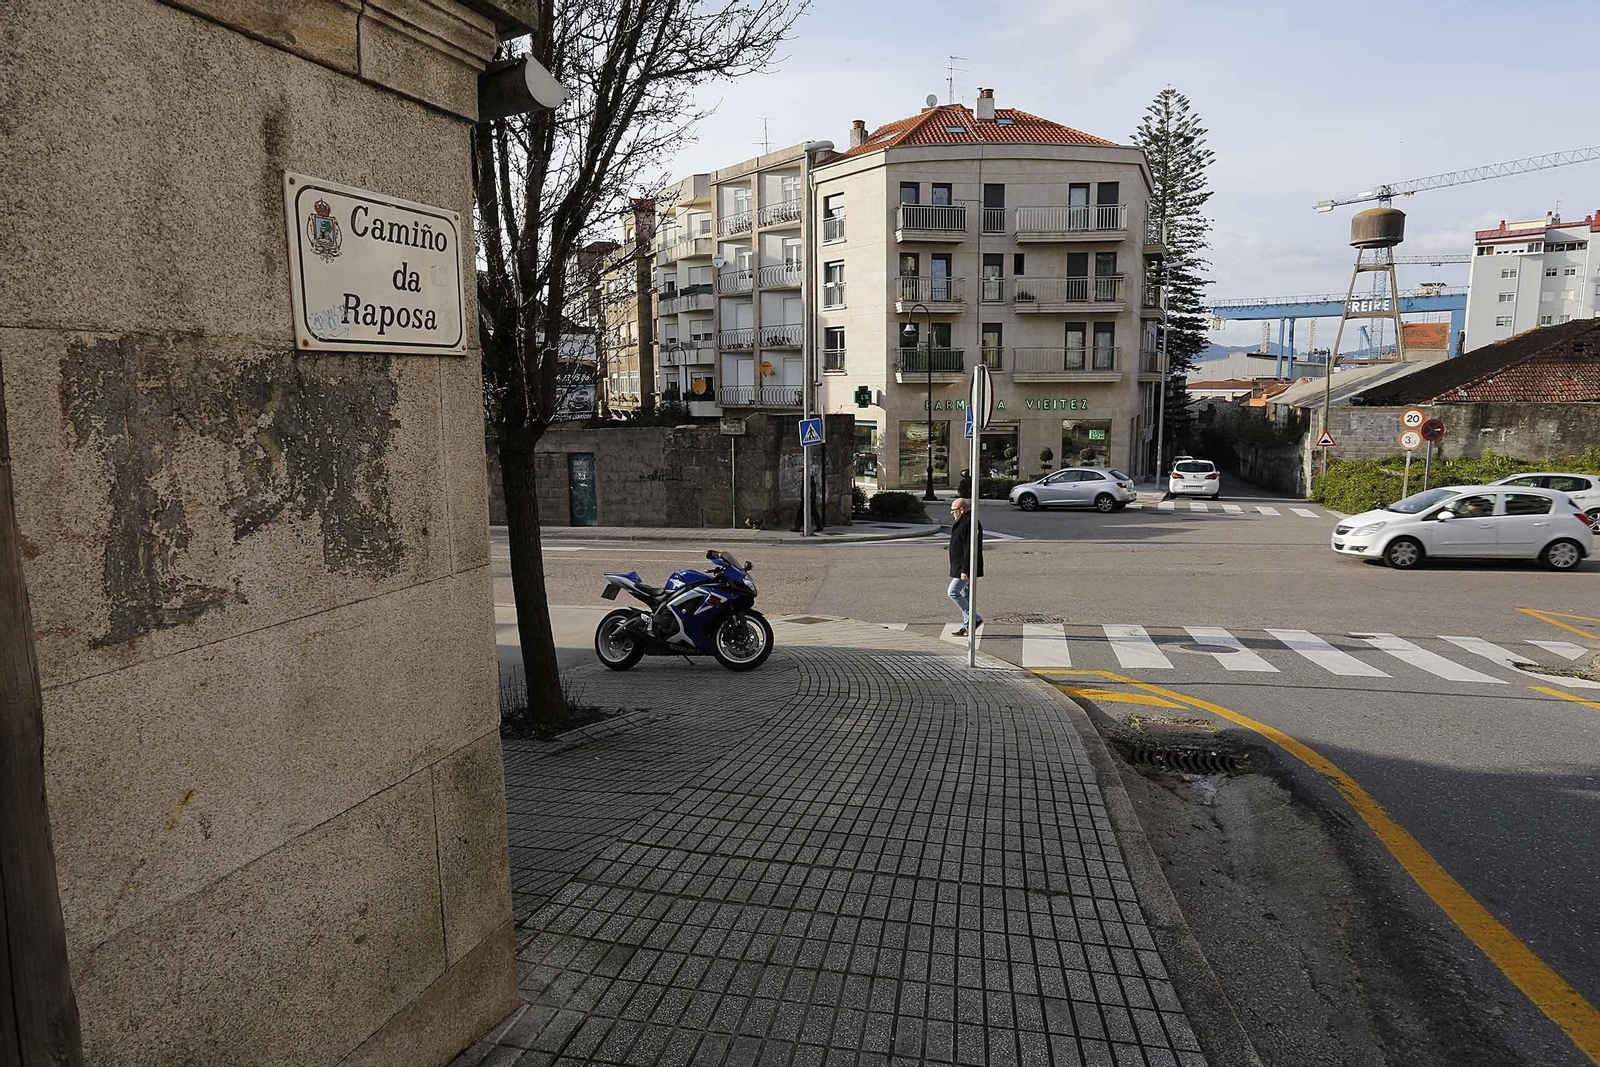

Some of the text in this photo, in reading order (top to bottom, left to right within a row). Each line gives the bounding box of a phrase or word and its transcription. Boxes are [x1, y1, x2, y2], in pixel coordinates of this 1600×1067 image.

[350, 205, 448, 252] Camiño
[392, 262, 422, 292] da
[341, 293, 438, 335] Raposa
[925, 400, 1088, 410] FARMA VIEITEZ
[1406, 414, 1420, 423] 20
